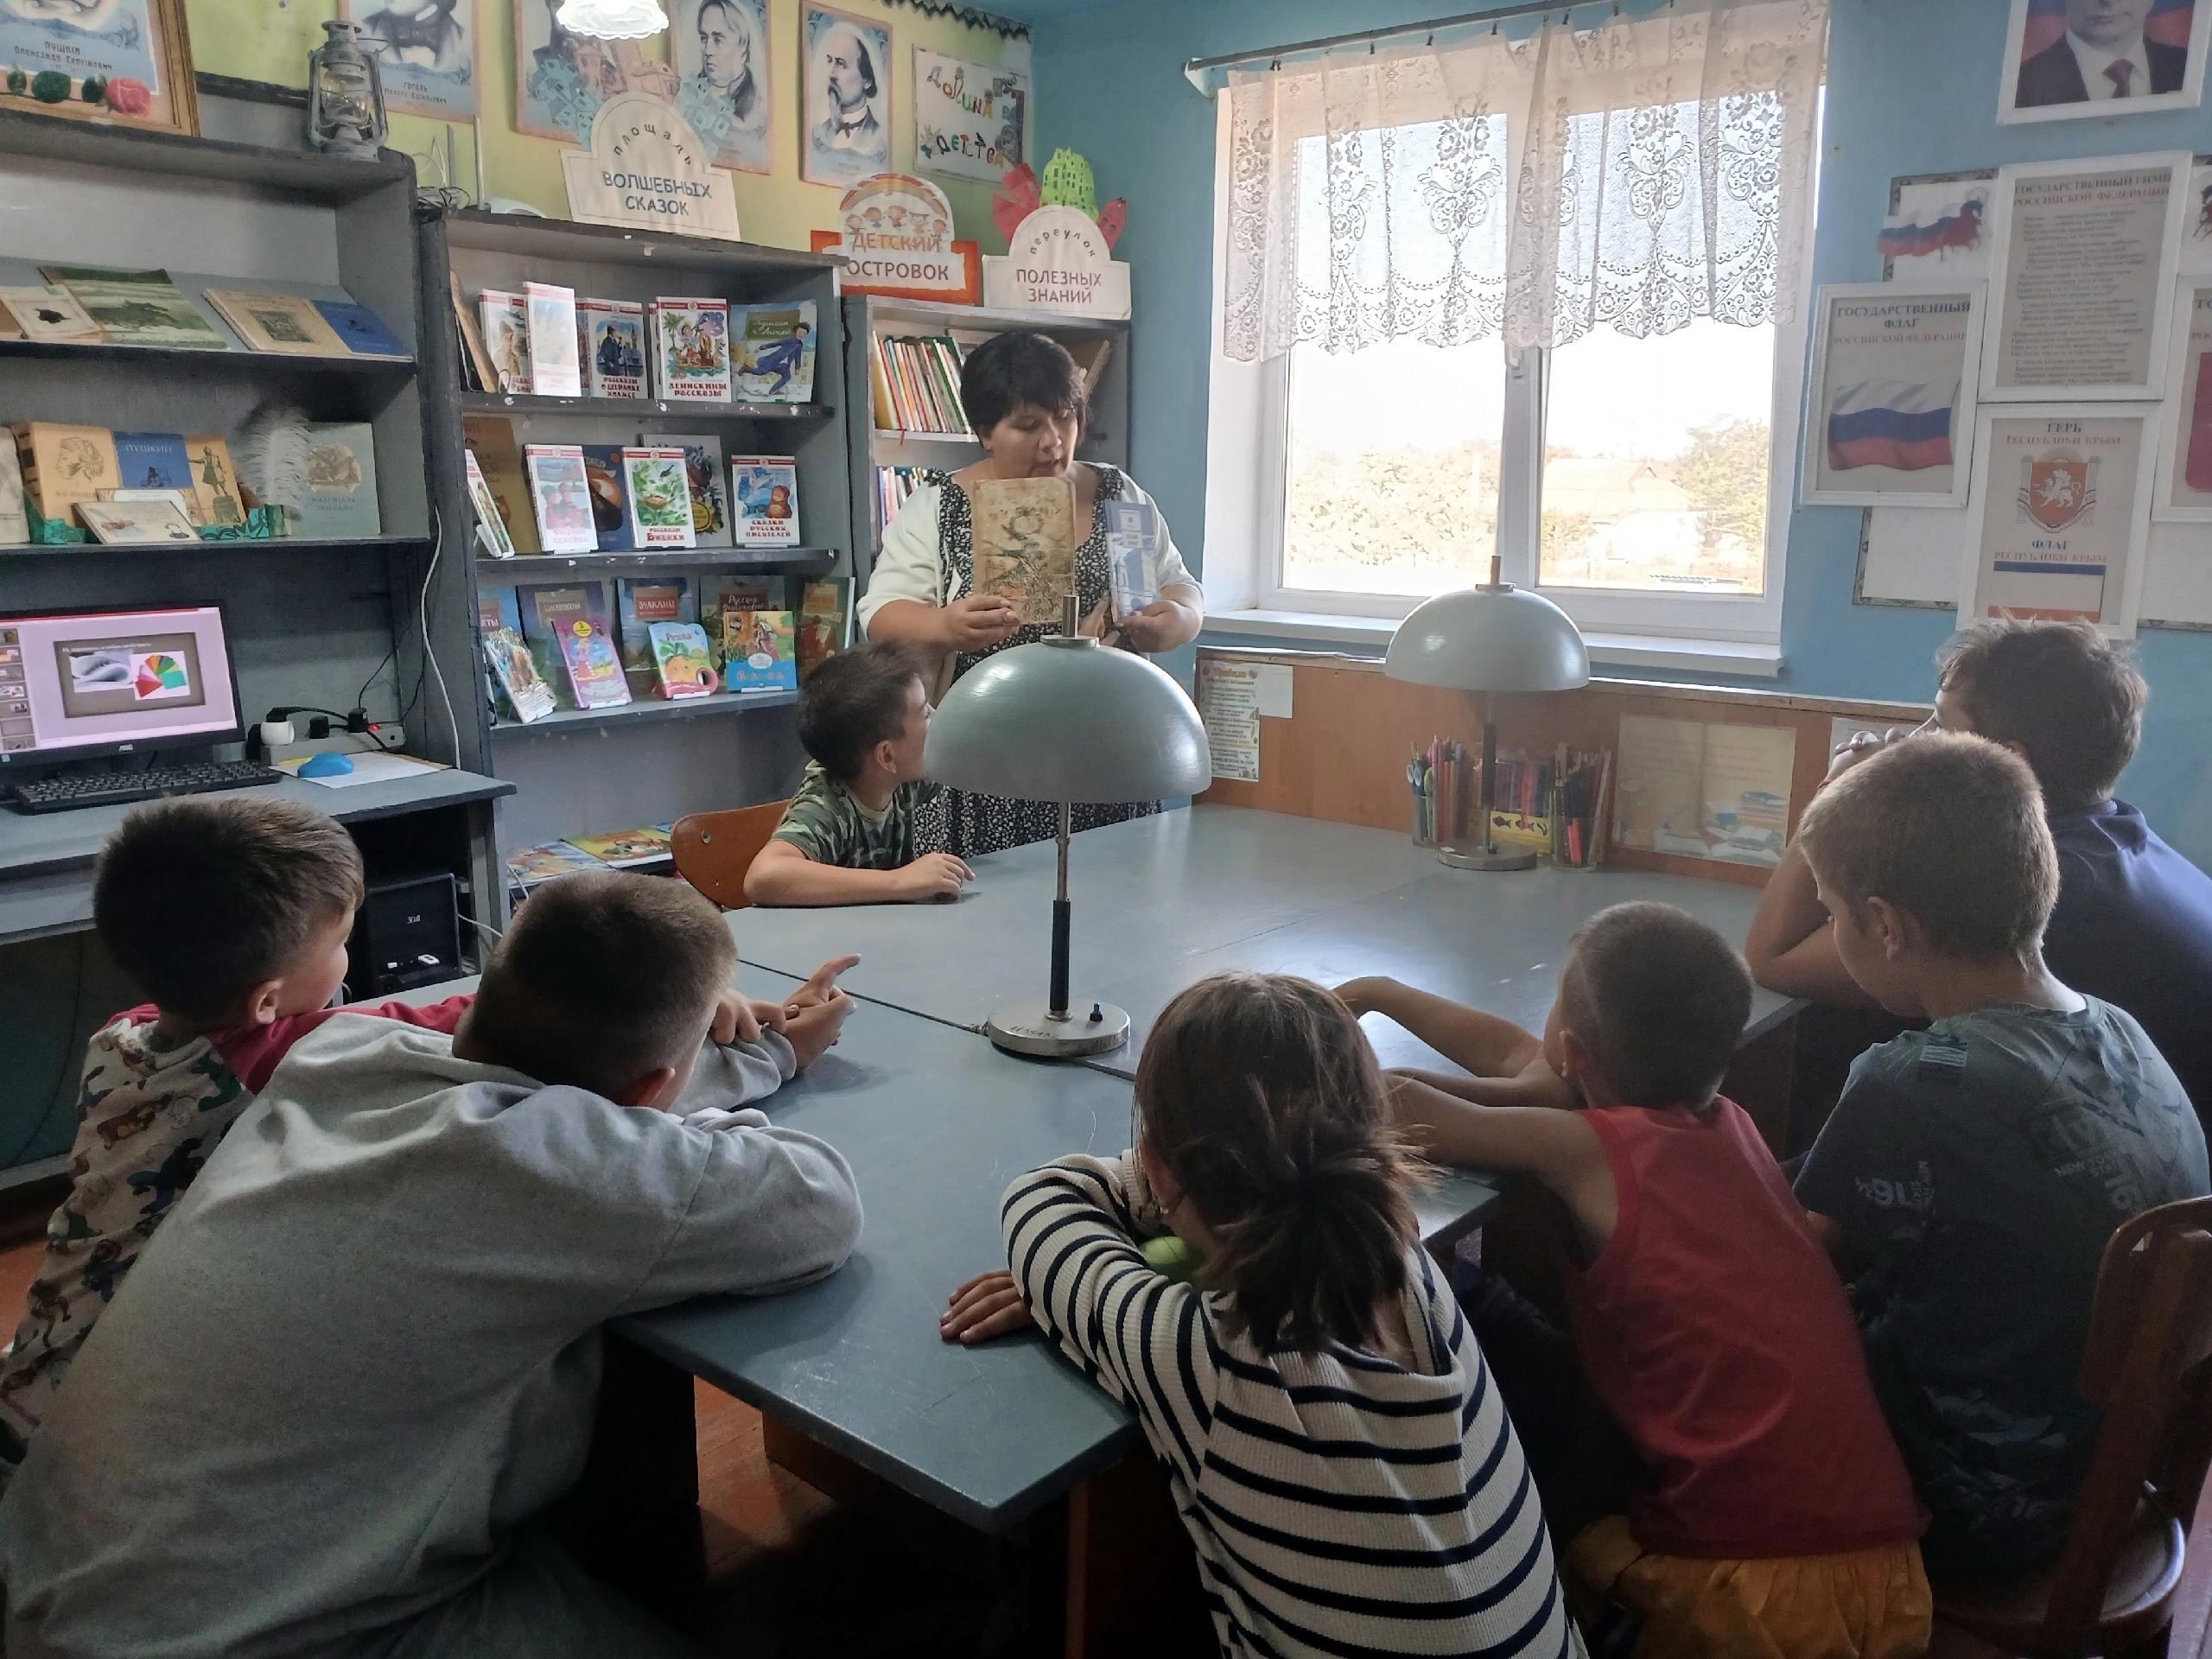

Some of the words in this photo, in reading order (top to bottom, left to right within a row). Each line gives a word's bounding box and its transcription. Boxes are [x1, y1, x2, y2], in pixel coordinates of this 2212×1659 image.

[404, 81, 428, 92] ГОГОЛЬ
[613, 124, 692, 165] площадь
[936, 131, 1005, 169] ДЕТСТВА
[602, 171, 713, 199] ВОЛШЕБНЫХ
[2014, 175, 2133, 194] ГОСУДАРСТВЕННЫЙ
[625, 195, 689, 216] СКАЗОК
[2013, 191, 2092, 207] РОССИЙСКОЙ
[851, 232, 941, 253] ДЕТСКИЙ
[1029, 228, 1096, 257] переулок
[847, 259, 949, 281] ОСТРОВОК
[1016, 269, 1103, 287] ПОЛЕЗНЫХ
[1028, 287, 1092, 304] ЗНАНИЙ
[1837, 302, 1971, 317] ГОСУДАРСТВЕННЫЙ
[1883, 318, 1921, 328] ФЛАГ
[1834, 334, 1904, 345] РОССИЙСКОЙ
[2046, 423, 2082, 433] ГЕРБ
[2006, 435, 2082, 445] РЕСПУБЛИКИ
[2085, 435, 2121, 445] КРЫМ
[2032, 539, 2071, 550] ФЛАГ
[1994, 551, 2069, 562] РЕСПУБЛИКИ
[2072, 553, 2107, 563] КРЫМ
